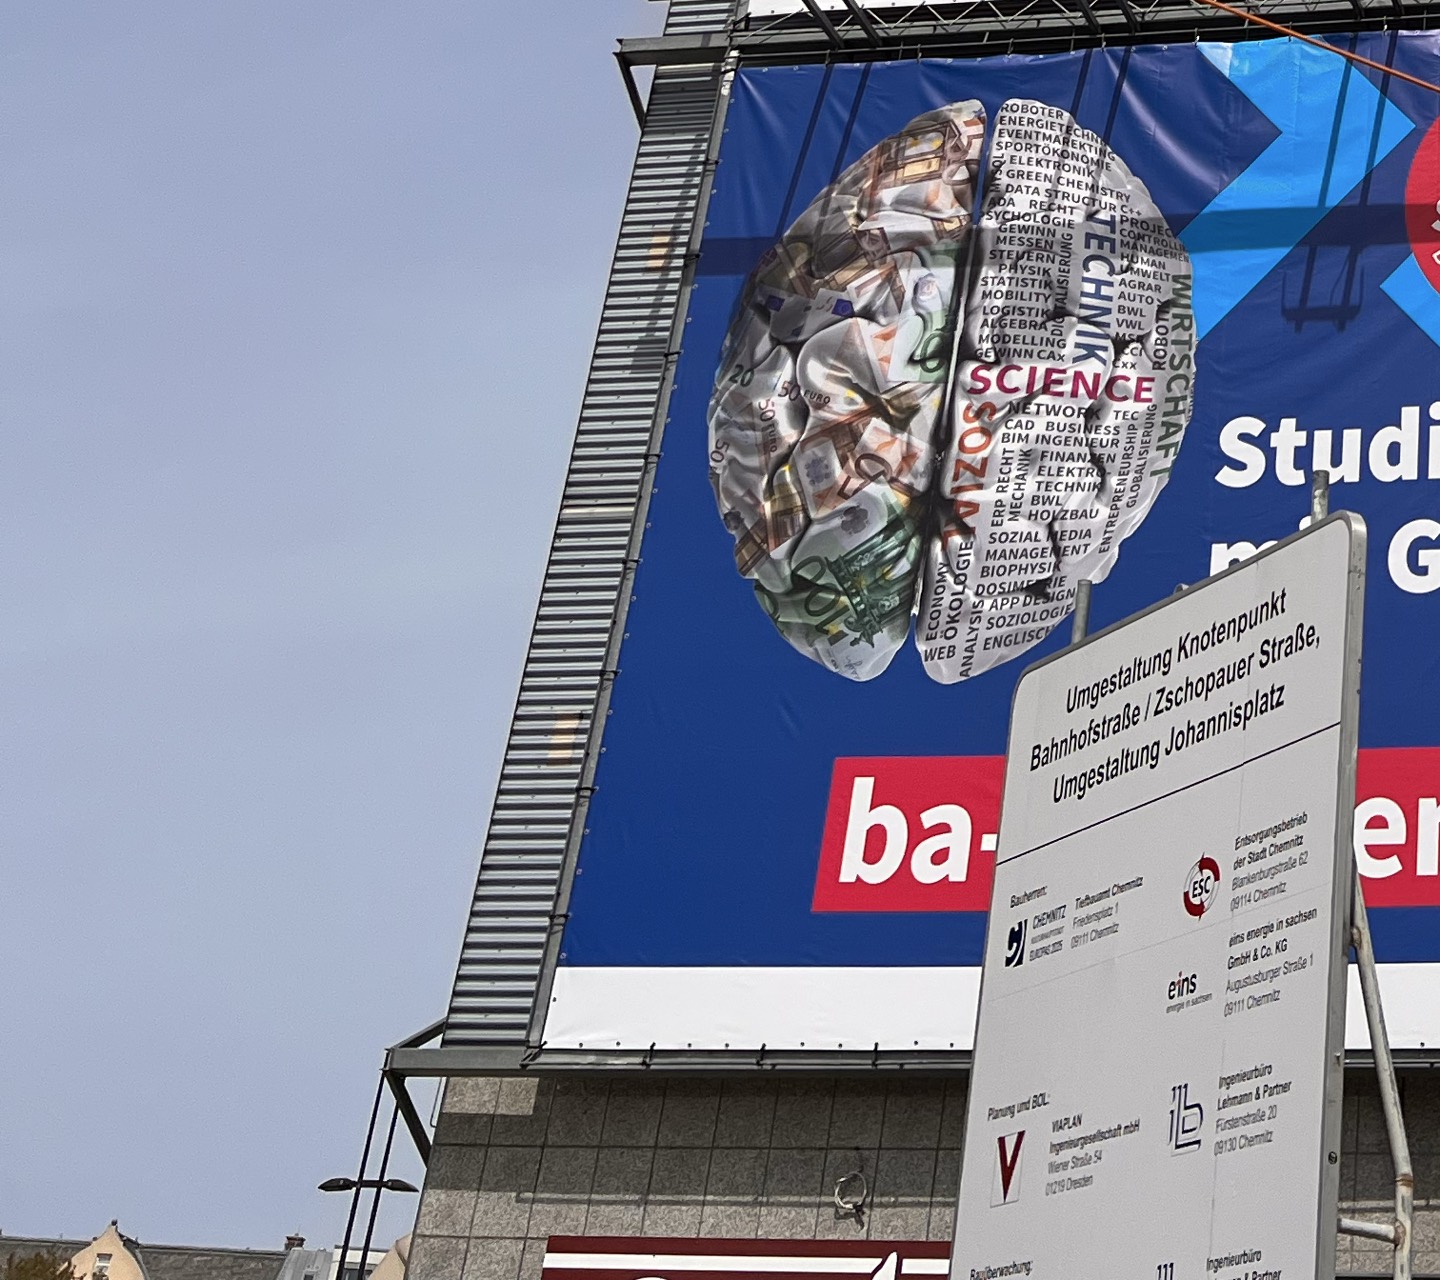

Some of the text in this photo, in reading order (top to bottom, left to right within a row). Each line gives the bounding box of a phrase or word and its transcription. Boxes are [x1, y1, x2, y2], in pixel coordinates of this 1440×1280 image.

[1001, 104, 1063, 120] ROBOTER
[996, 141, 1111, 171] SPORTÖKONOMIE
[998, 129, 1116, 162] EVENTMAREKTING
[1010, 155, 1095, 179] ELEKTRONIK
[1006, 184, 1116, 213] DATA STRUCTUR
[1007, 170, 1130, 202] GREEN CHEMISTRY
[1029, 200, 1076, 215] RECHT
[981, 276, 1053, 290] STATISTIK
[999, 264, 1051, 276] PHYSIK
[981, 290, 1051, 303] MOBILITY
[1072, 214, 1116, 366] TECHNIK
[1118, 291, 1153, 305] AUTO
[1119, 278, 1162, 293] AGRAR
[1116, 318, 1144, 330] VWL
[1117, 305, 1146, 318] BWL
[967, 364, 1155, 403] SCIENCE
[1008, 402, 1101, 420] NETWORK
[1001, 432, 1120, 449] BIM INGENIEUR
[1004, 420, 1121, 436] CAD BUSINESS
[1126, 404, 1157, 509] GLOBALISIERUNG
[1008, 448, 1033, 522] MECHANIK
[1098, 423, 1139, 554] ENTREPRENEURSHIP
[1031, 495, 1063, 507] BWL
[939, 540, 974, 640] ÖKOLOGIE
[959, 599, 985, 678] ANALYSIS
[1066, 587, 1286, 713] Umgestaltung Knotenpunkt
[924, 645, 956, 663] WEB
[1030, 703, 1141, 772] Bahnhofstraße
[1153, 652, 1255, 718] Zschopauer
[1259, 622, 1320, 669] Straße,
[1053, 684, 1285, 803] Umgestaltung Johannisplatz
[1235, 811, 1308, 851] Entsorgungsbetrieb
[1233, 834, 1304, 871] der Stadt Chemnitz
[1192, 875, 1211, 899] ESC
[1229, 932, 1244, 947] eins
[1246, 921, 1274, 939] energie
[1285, 907, 1317, 926] sachsen
[1228, 938, 1288, 970] GmbH & Co. KG
[1168, 971, 1197, 1000] eins
[1219, 1063, 1273, 1090] Ingenieurbüro
[1217, 1081, 1292, 1111] Lehmann & Partner
